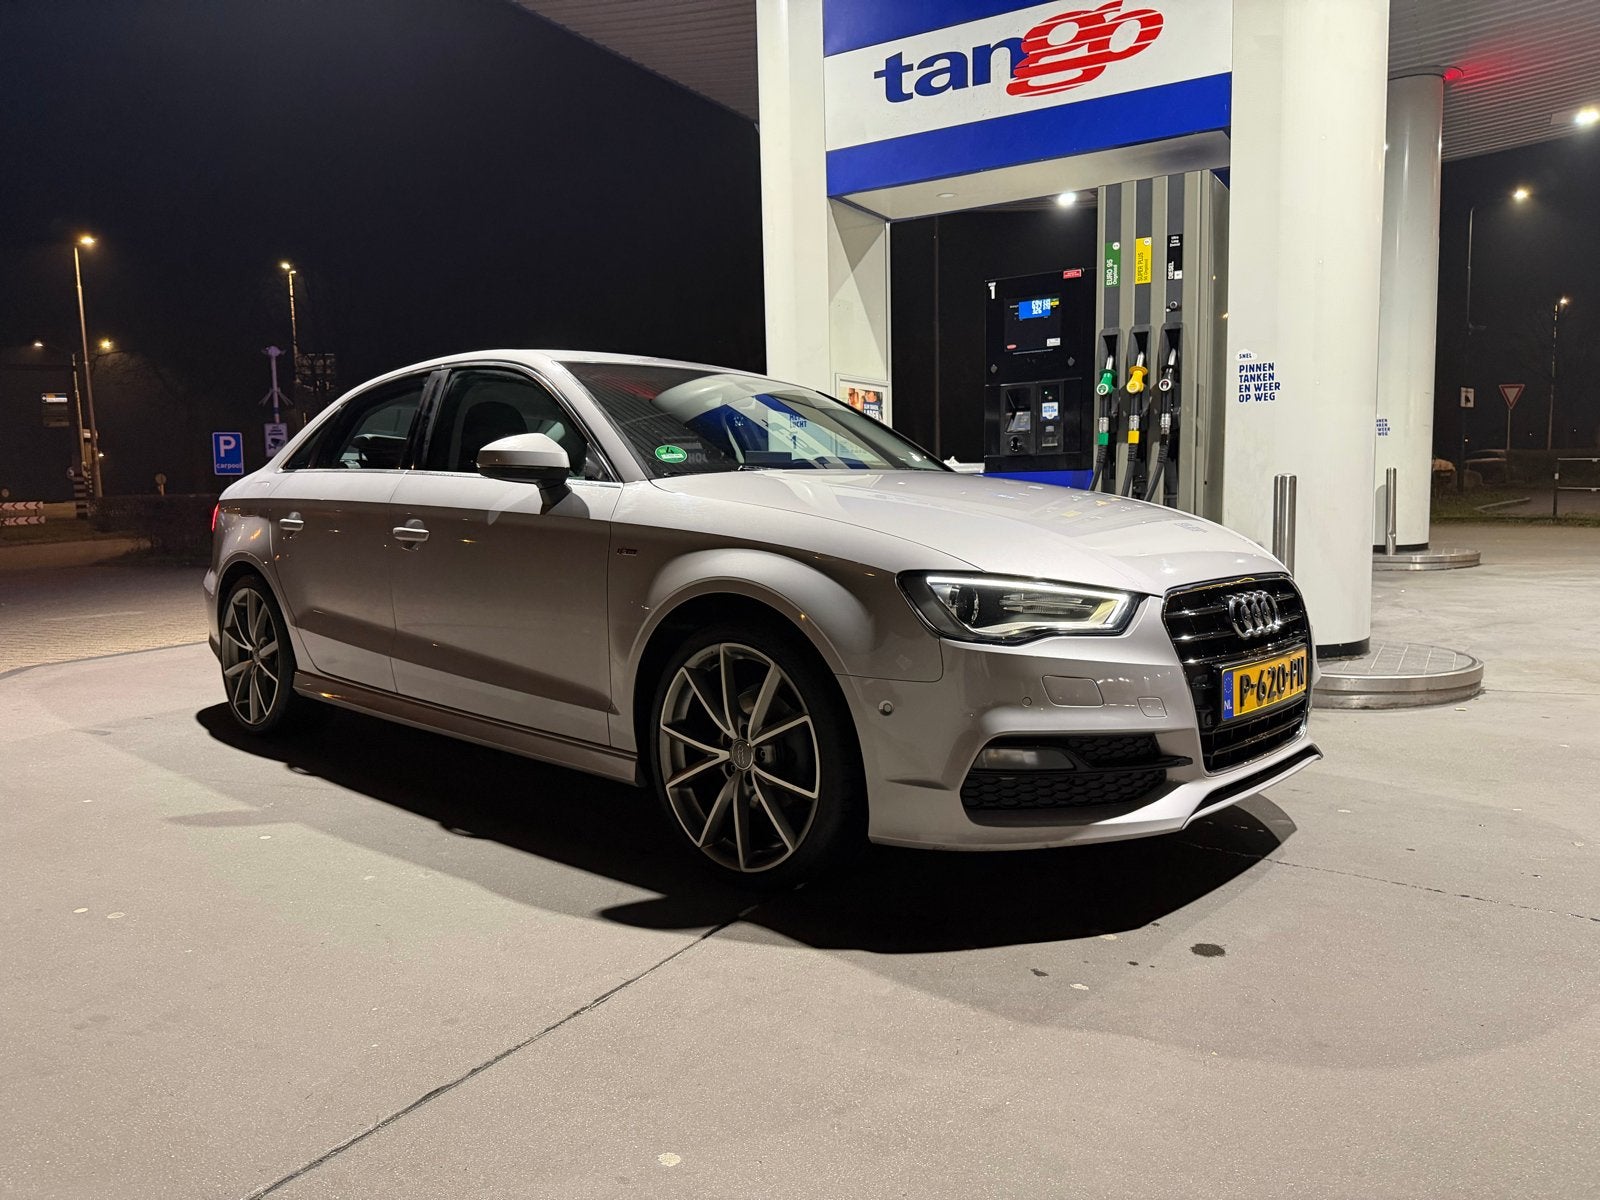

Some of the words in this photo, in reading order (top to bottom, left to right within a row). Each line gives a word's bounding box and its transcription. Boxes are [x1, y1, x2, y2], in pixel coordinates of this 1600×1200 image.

[874, 0, 1164, 103] tango
[1106, 258, 1113, 268] 95
[1167, 261, 1175, 280] DIESEL
[1239, 362, 1274, 374] PINNEN
[1238, 372, 1275, 384] TANKEN
[1238, 384, 1251, 393] EN
[1253, 382, 1281, 392] WEER
[1238, 393, 1251, 403] OP
[1254, 392, 1275, 402] WEG
[219, 435, 236, 458] P
[1223, 699, 1233, 710] NL
